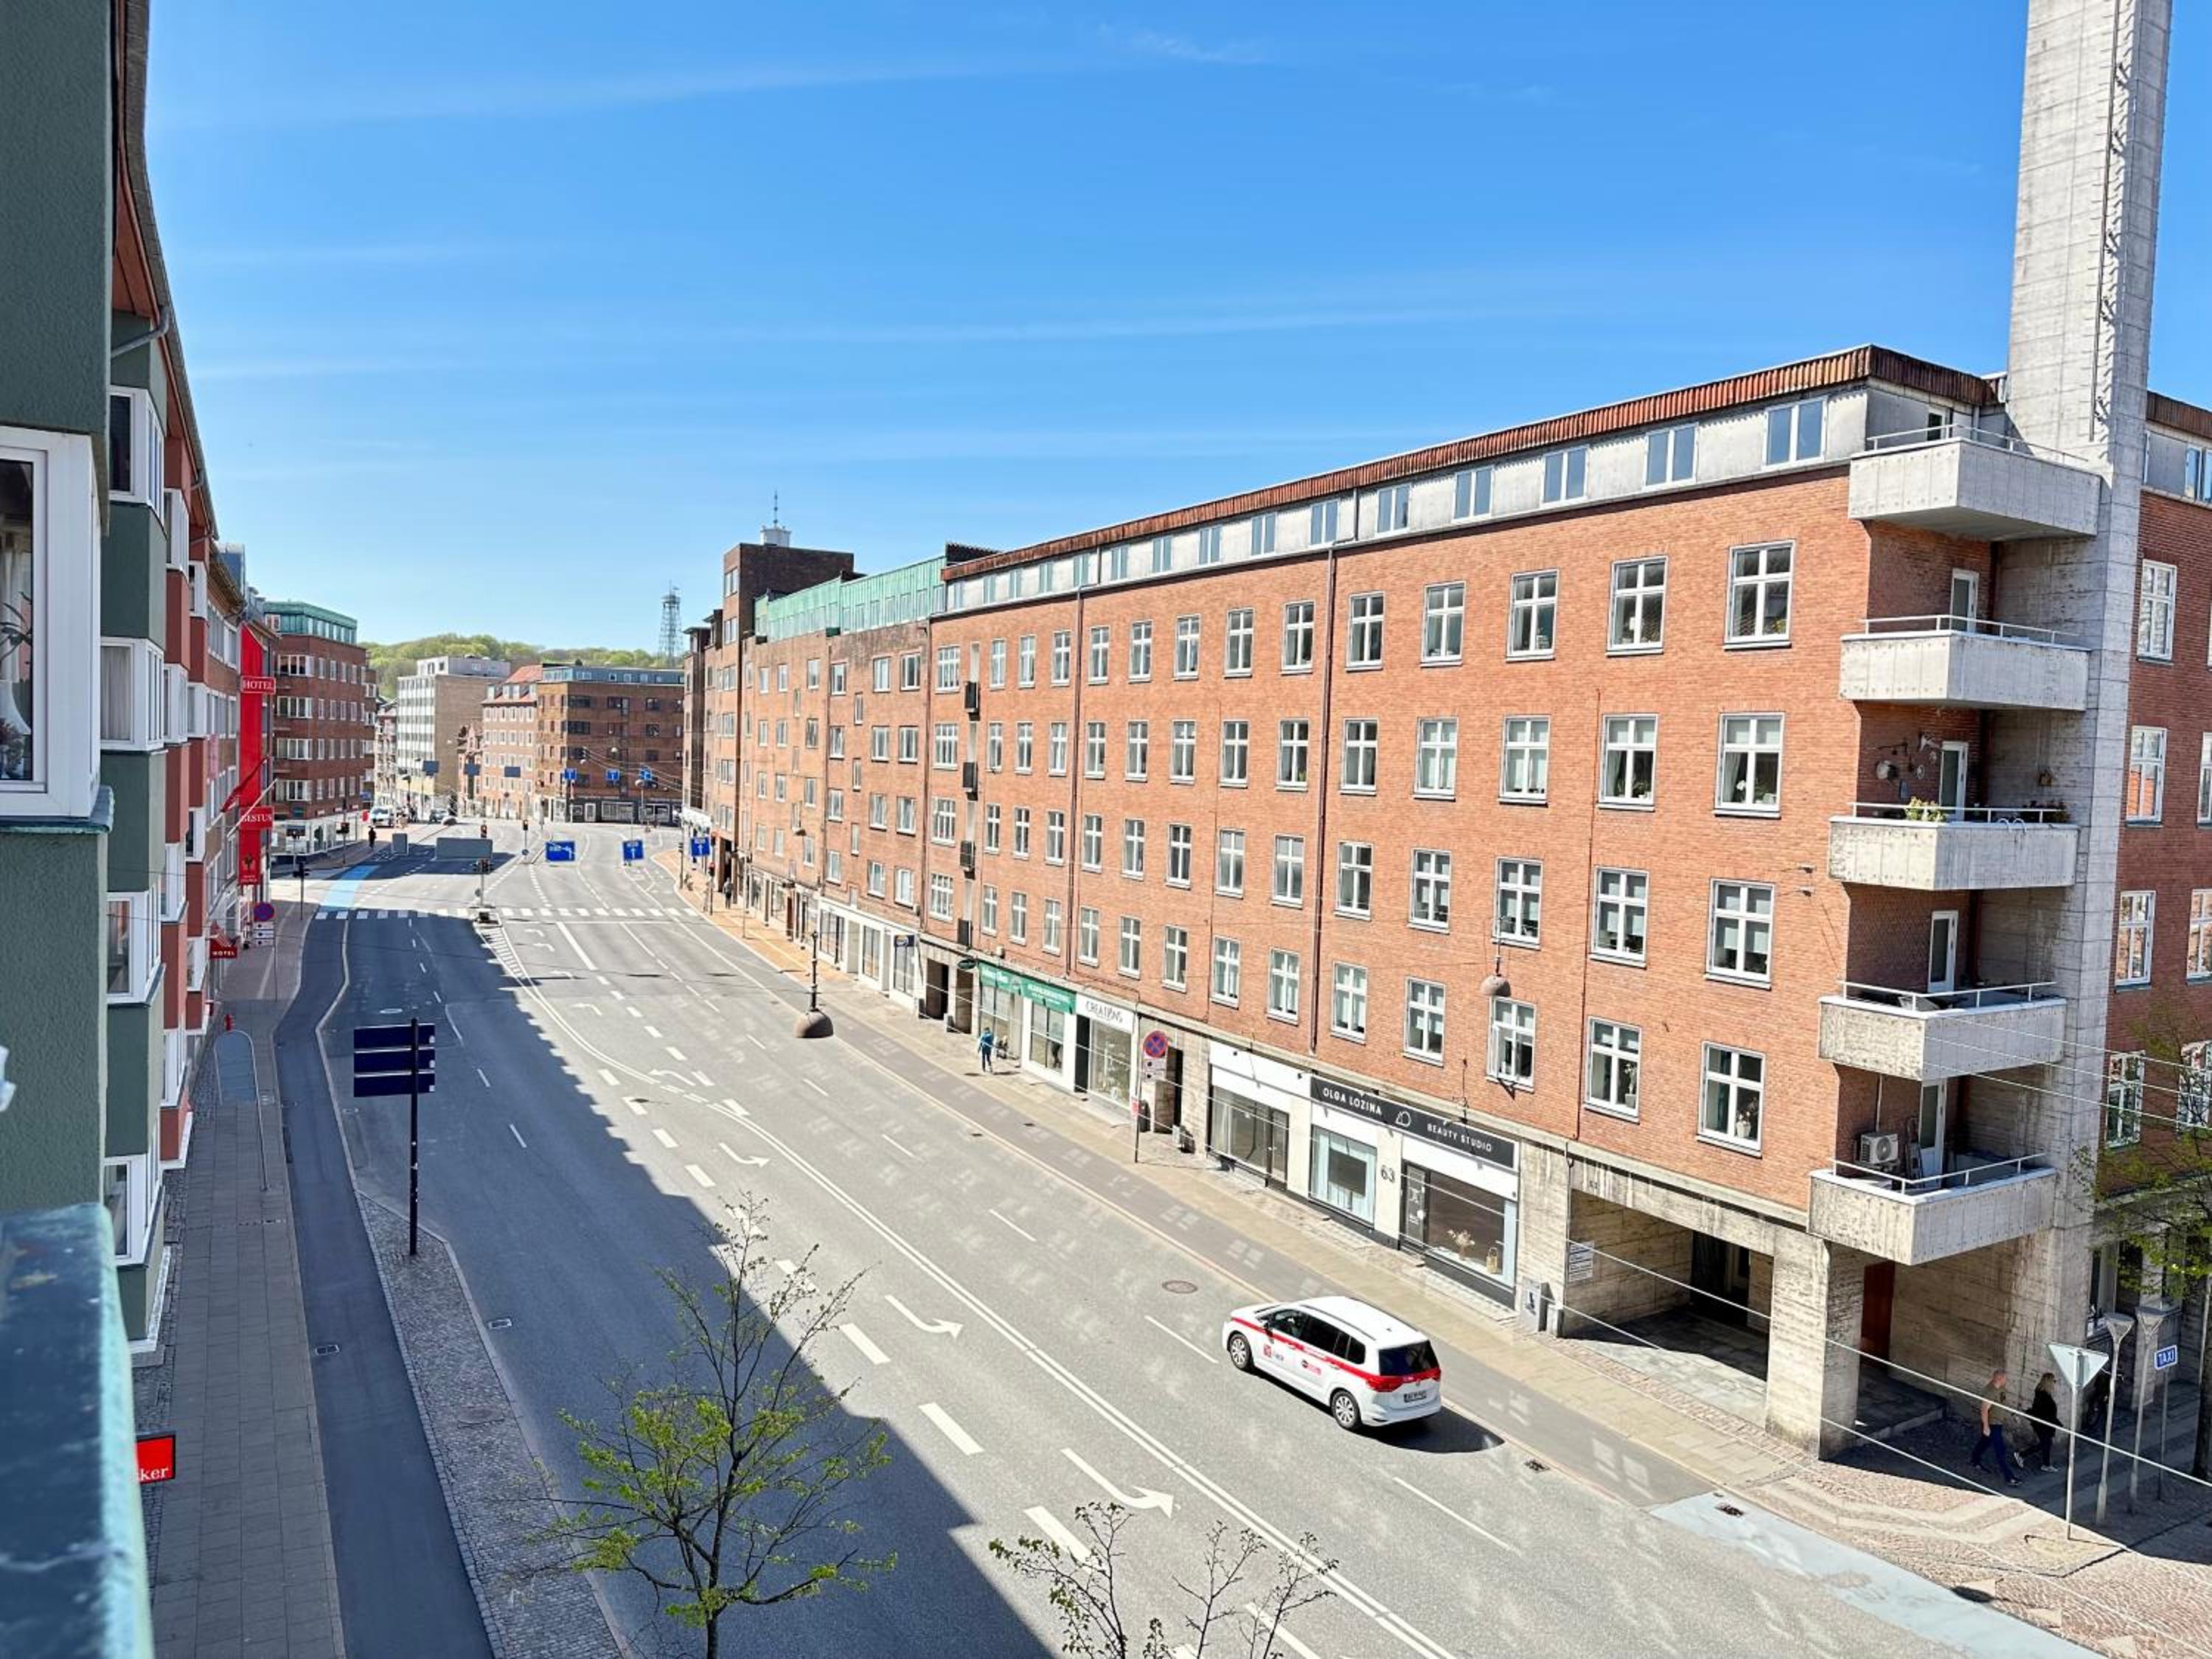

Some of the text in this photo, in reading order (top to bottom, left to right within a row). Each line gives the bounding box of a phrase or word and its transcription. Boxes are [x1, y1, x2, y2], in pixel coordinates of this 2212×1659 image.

[243, 680, 272, 689] HOTEL
[1322, 1088, 1382, 1116] OLGA LOZINA
[1427, 1123, 1492, 1152] BEAUTY STUDIO
[1380, 1164, 1395, 1183] 63
[2158, 1349, 2174, 1365] TAXI
[137, 1467, 169, 1481] ker
